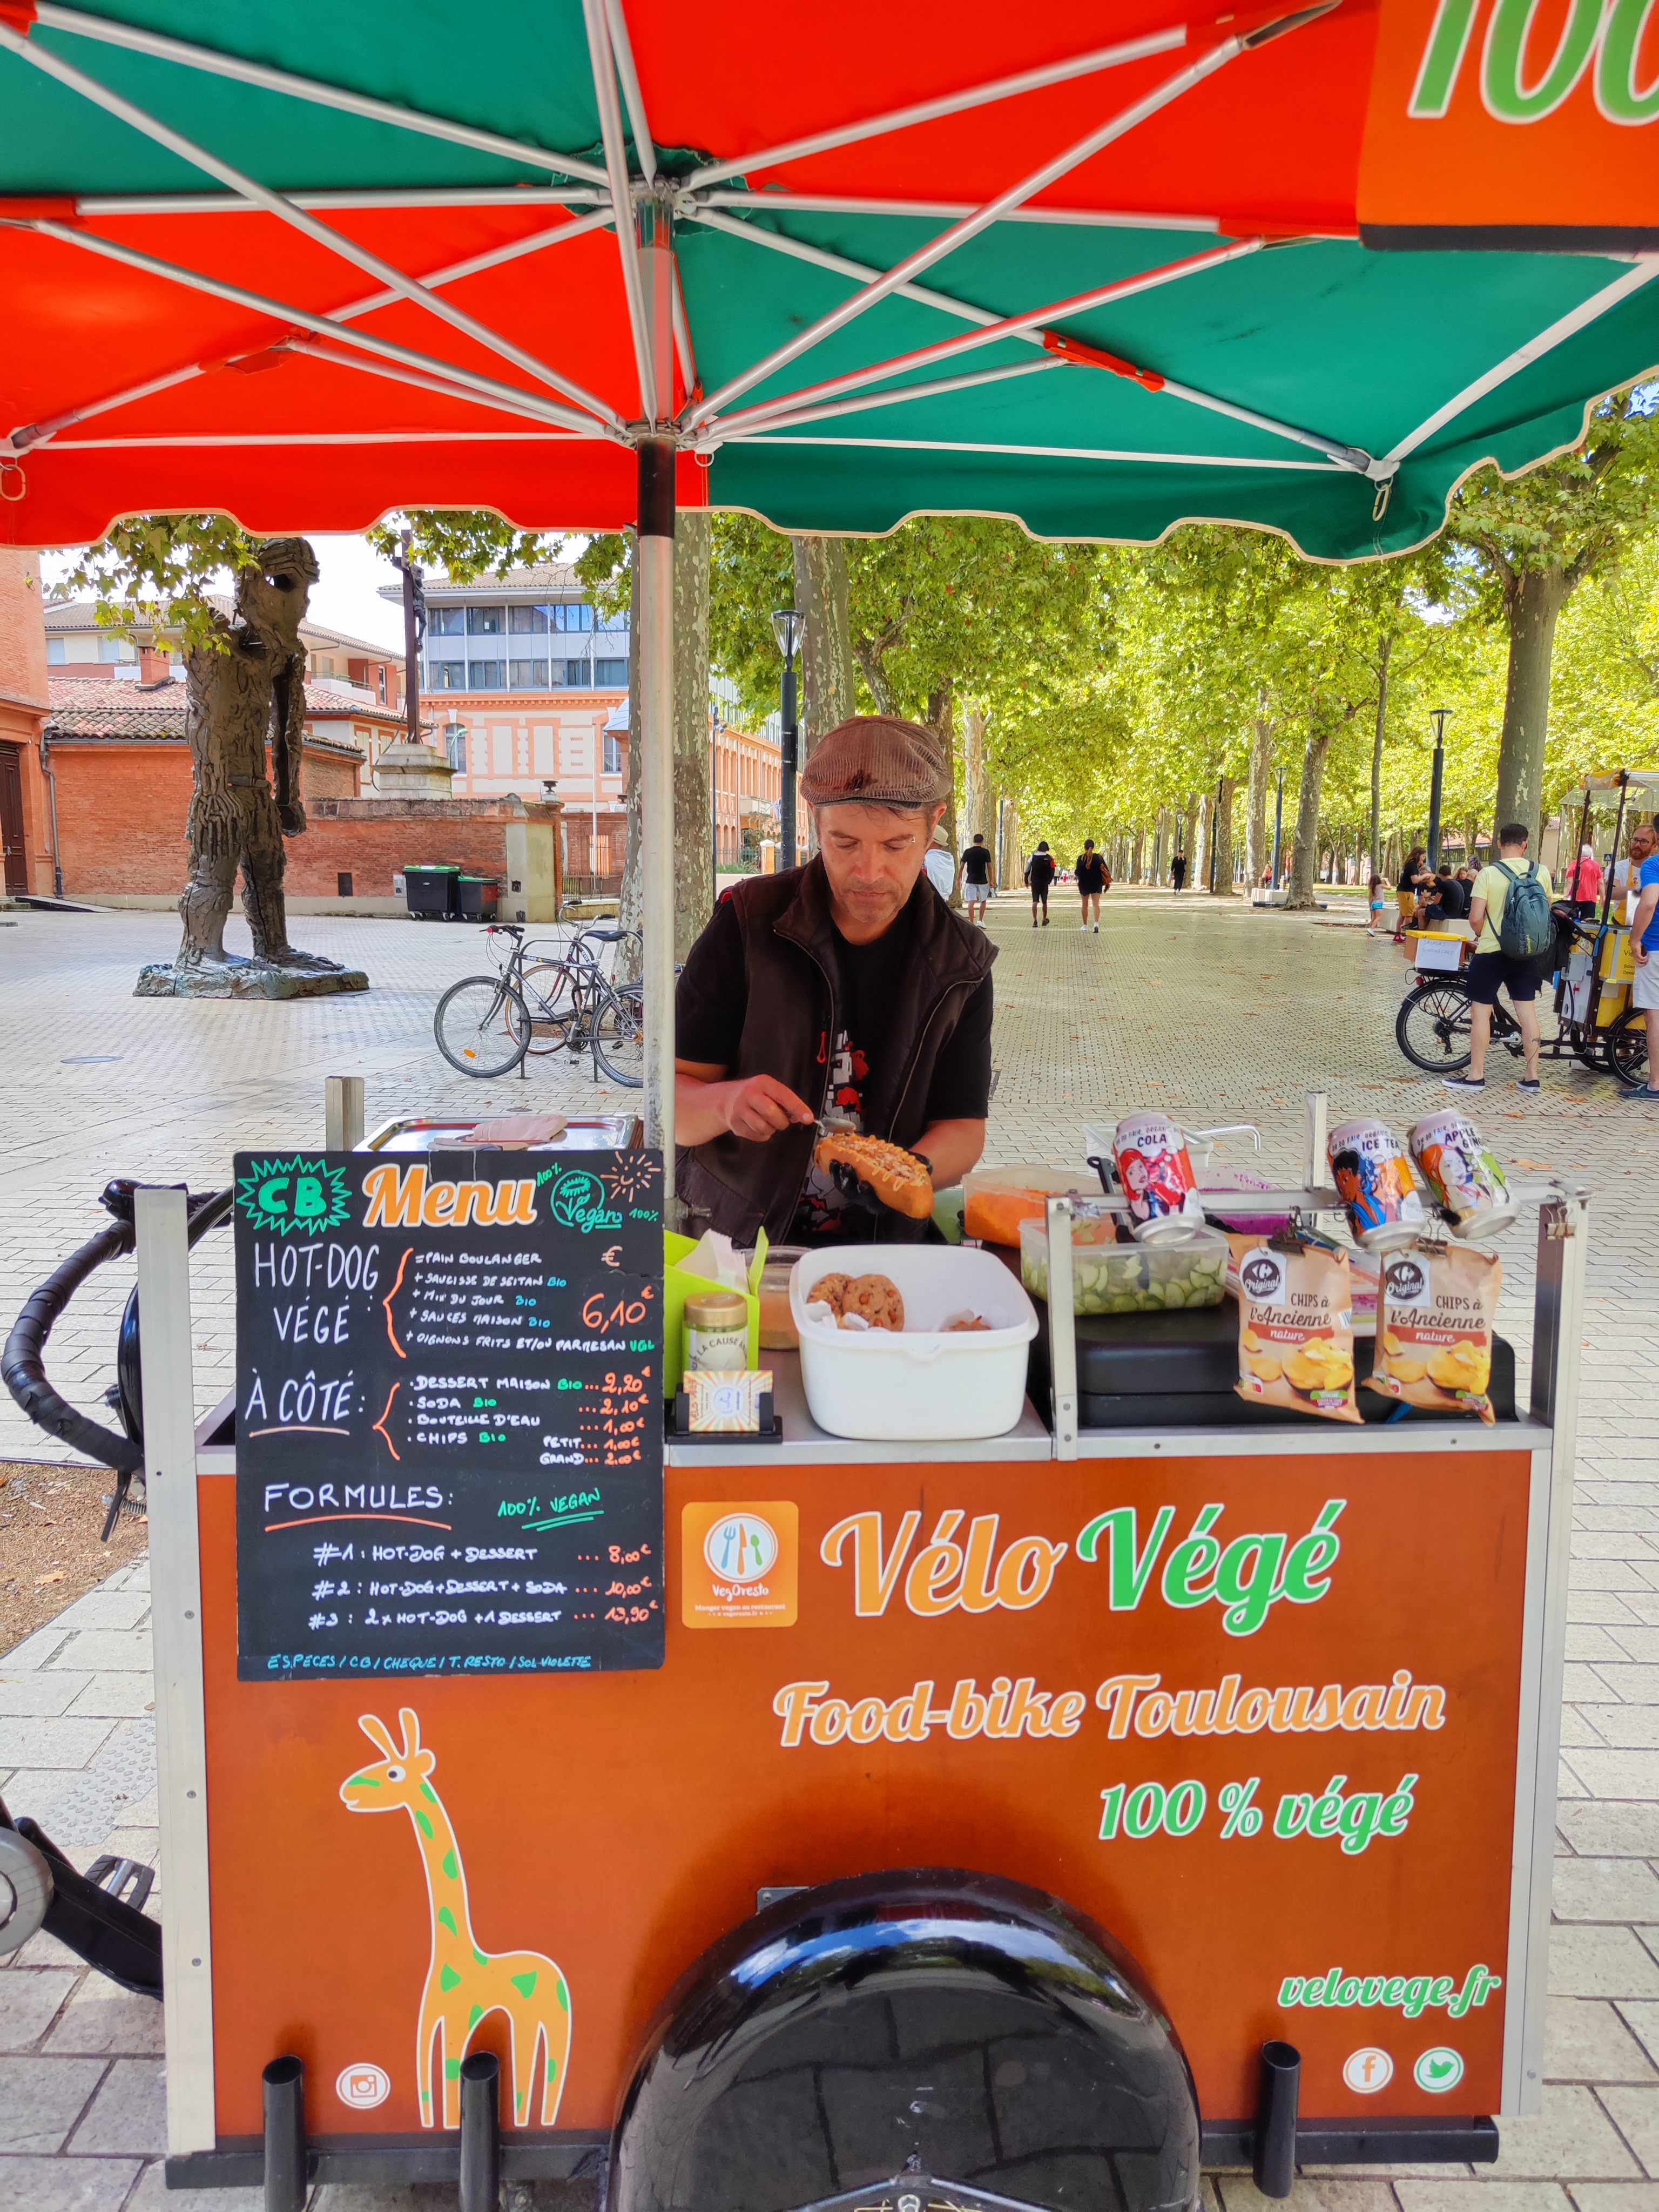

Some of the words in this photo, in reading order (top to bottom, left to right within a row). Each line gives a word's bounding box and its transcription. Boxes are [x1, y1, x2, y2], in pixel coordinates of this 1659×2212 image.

[1137, 1134, 1167, 1148] COLA
[1361, 1139, 1379, 1151] ICE
[1384, 1138, 1400, 1150] TEA
[258, 1177, 327, 1217] CB
[361, 1163, 537, 1228] Menu
[556, 1195, 623, 1233] Vegan
[629, 1208, 659, 1222] 100%
[459, 1252, 542, 1265] BOULANGER
[602, 1245, 623, 1267] €
[254, 1242, 380, 1291] HOT-DOG
[425, 1272, 477, 1285] SAUCISSE
[482, 1276, 497, 1287] DE
[500, 1275, 543, 1287] SEITAN
[547, 1276, 567, 1287] BIO
[1244, 1274, 1280, 1294] Original
[1386, 1277, 1424, 1297] Original
[450, 1293, 466, 1305] DU
[470, 1294, 504, 1306] JOUR
[515, 1295, 537, 1306] BIO
[1291, 1293, 1318, 1307] CHIPS
[1321, 1296, 1330, 1307] à
[1435, 1295, 1469, 1310] CHIPS
[1473, 1299, 1483, 1310] à
[274, 1295, 350, 1344] VÉGÉ
[420, 1310, 467, 1324] SAUCES
[473, 1314, 523, 1326] MAISON
[528, 1316, 551, 1328] BIO
[1250, 1306, 1332, 1326] l'Ancienne
[1391, 1307, 1486, 1329] l'Ancienne
[416, 1333, 470, 1346] OIGNONS
[475, 1336, 511, 1349] FRITS
[516, 1337, 552, 1351] ET/OU
[555, 1339, 626, 1353] PARMESAN
[1270, 1329, 1305, 1341] nature
[1415, 1331, 1456, 1343] nature
[697, 1344, 708, 1356] LA
[709, 1337, 739, 1348] CAUSE
[413, 1375, 489, 1391] DESSERT
[496, 1377, 550, 1391] MAISON
[557, 1378, 583, 1390] BIO
[416, 1396, 461, 1410] SODA
[473, 1397, 497, 1408] BIO
[417, 1413, 490, 1426] BOUTEILLE
[493, 1414, 541, 1427] D'EAU
[416, 1432, 468, 1444] CHIPS
[479, 1432, 506, 1443] BIO
[497, 1496, 541, 1517] 100%
[550, 1488, 601, 1513] VEGAN
[373, 1545, 444, 1563] HOT-DOG
[465, 1547, 538, 1563] DESSERT
[820, 1509, 1068, 1616] Vélo
[1076, 1499, 1347, 1636] Végé
[525, 1581, 568, 1595] SODA
[712, 1583, 770, 1602] VegOresto
[397, 1609, 467, 1626] HOT-DOG
[497, 1610, 562, 1626] DESSERT
[267, 1654, 336, 1669] ESPECES
[349, 1656, 372, 1668] CB
[383, 1657, 436, 1671] CHEQUE
[464, 1655, 506, 1668] RESTO
[541, 1655, 592, 1669] VIOLETTE
[773, 1676, 1085, 1746] Food-bike
[1096, 1669, 1446, 1739] Toulousain
[1098, 1779, 1205, 1839] 100
[1219, 1777, 1263, 1839] %
[1273, 1773, 1419, 1854] végé
[1277, 1964, 1501, 2018] velovege.fr
